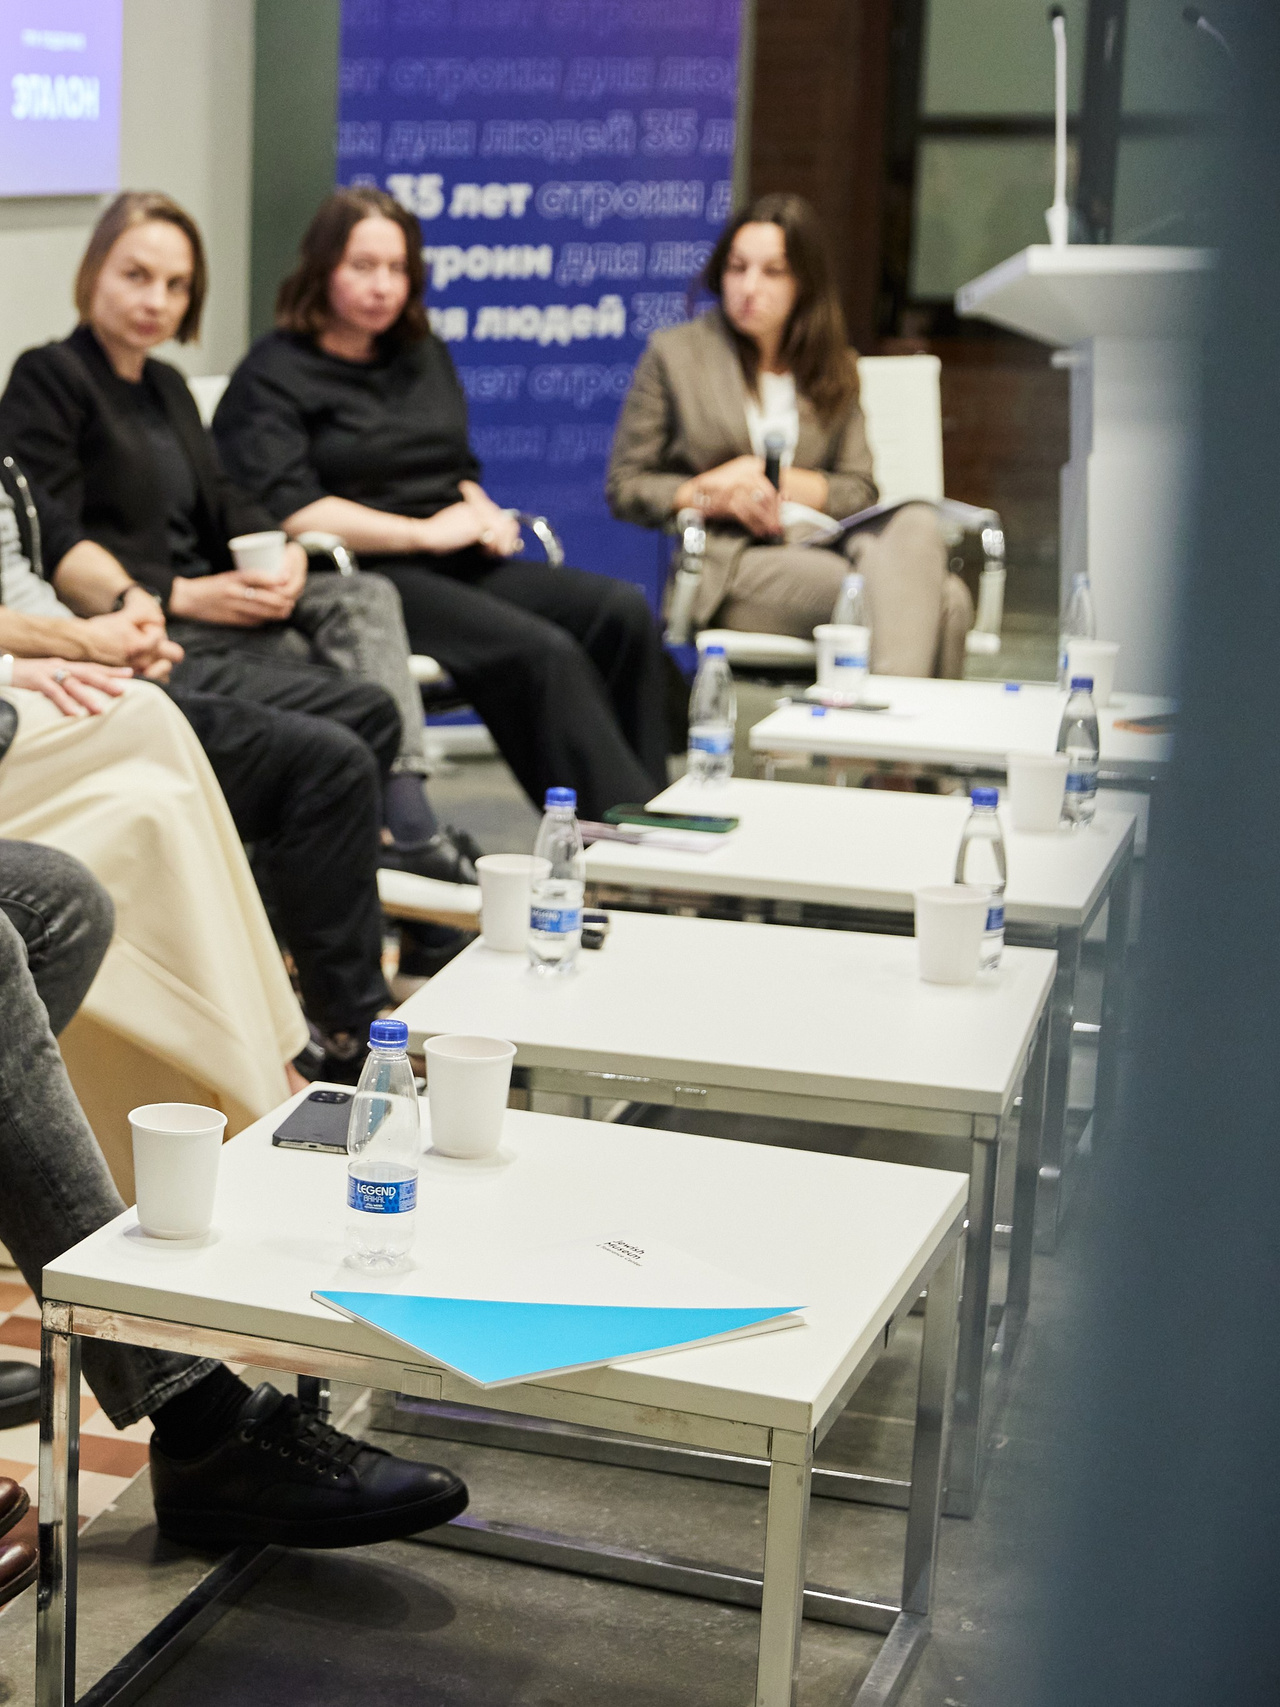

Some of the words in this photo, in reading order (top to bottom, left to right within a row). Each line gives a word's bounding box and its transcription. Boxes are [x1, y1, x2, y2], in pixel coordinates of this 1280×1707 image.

[386, 173, 445, 220] 35
[448, 182, 534, 219] лет
[473, 295, 627, 347] людей
[357, 1183, 396, 1198] LEGEND
[603, 1242, 641, 1260] Museum
